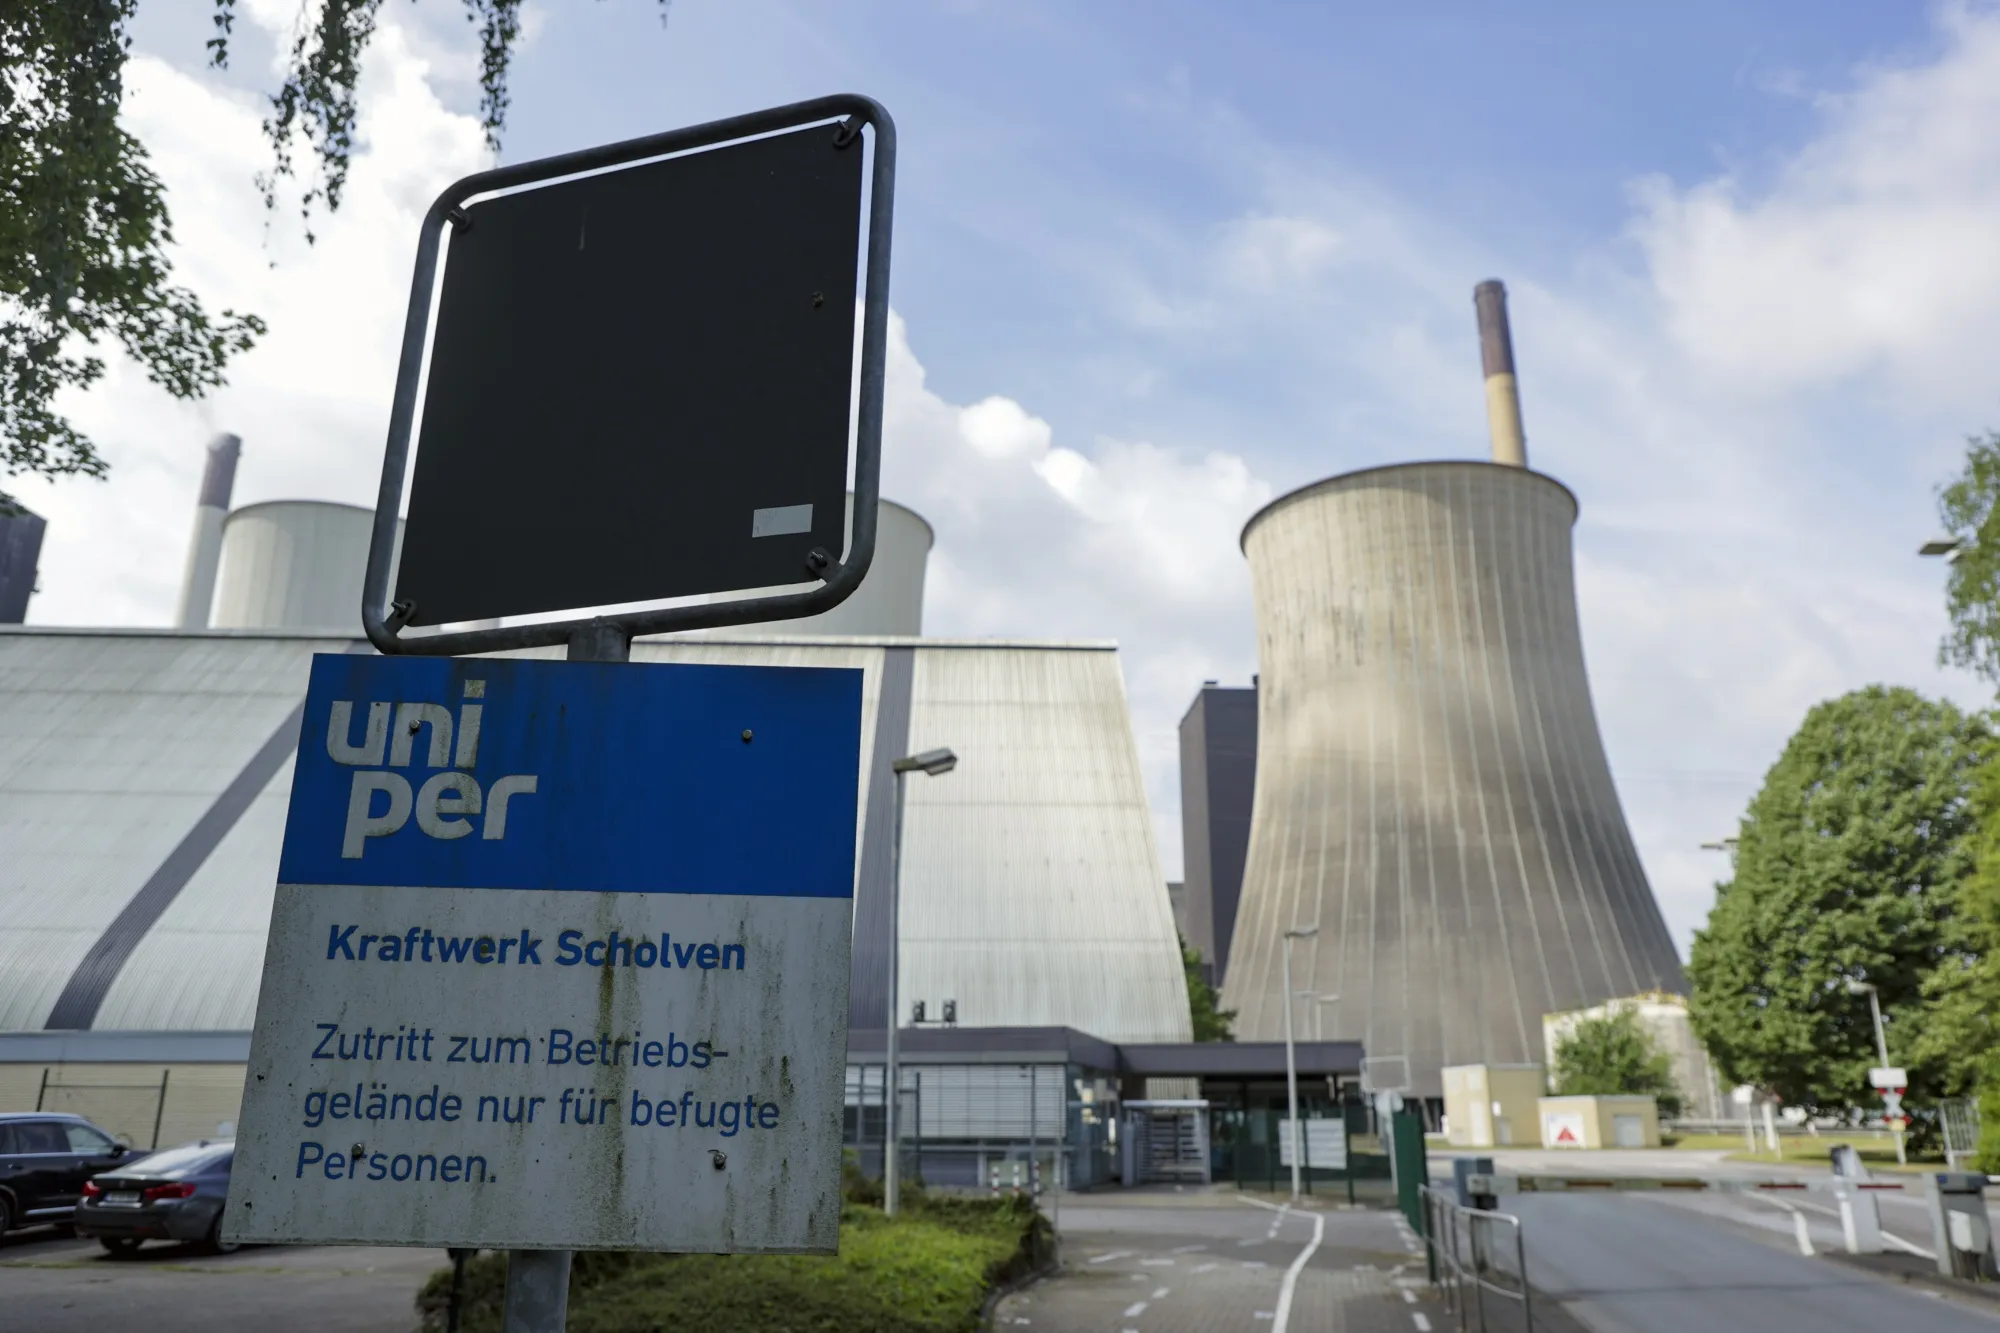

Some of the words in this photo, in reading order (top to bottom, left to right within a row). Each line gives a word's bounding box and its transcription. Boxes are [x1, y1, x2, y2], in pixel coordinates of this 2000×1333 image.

[326, 679, 486, 768] uni
[342, 770, 538, 859] per
[328, 925, 542, 965] Kraftwerk
[555, 931, 745, 969] Scholven
[312, 1024, 434, 1062] Zutritt
[447, 1037, 531, 1064] zum
[548, 1029, 729, 1069] Betriebs-
[303, 1084, 463, 1128] gelände
[477, 1097, 544, 1124] nur
[559, 1088, 618, 1126] für
[630, 1091, 780, 1137] befugte
[296, 1141, 498, 1184] Personen.
